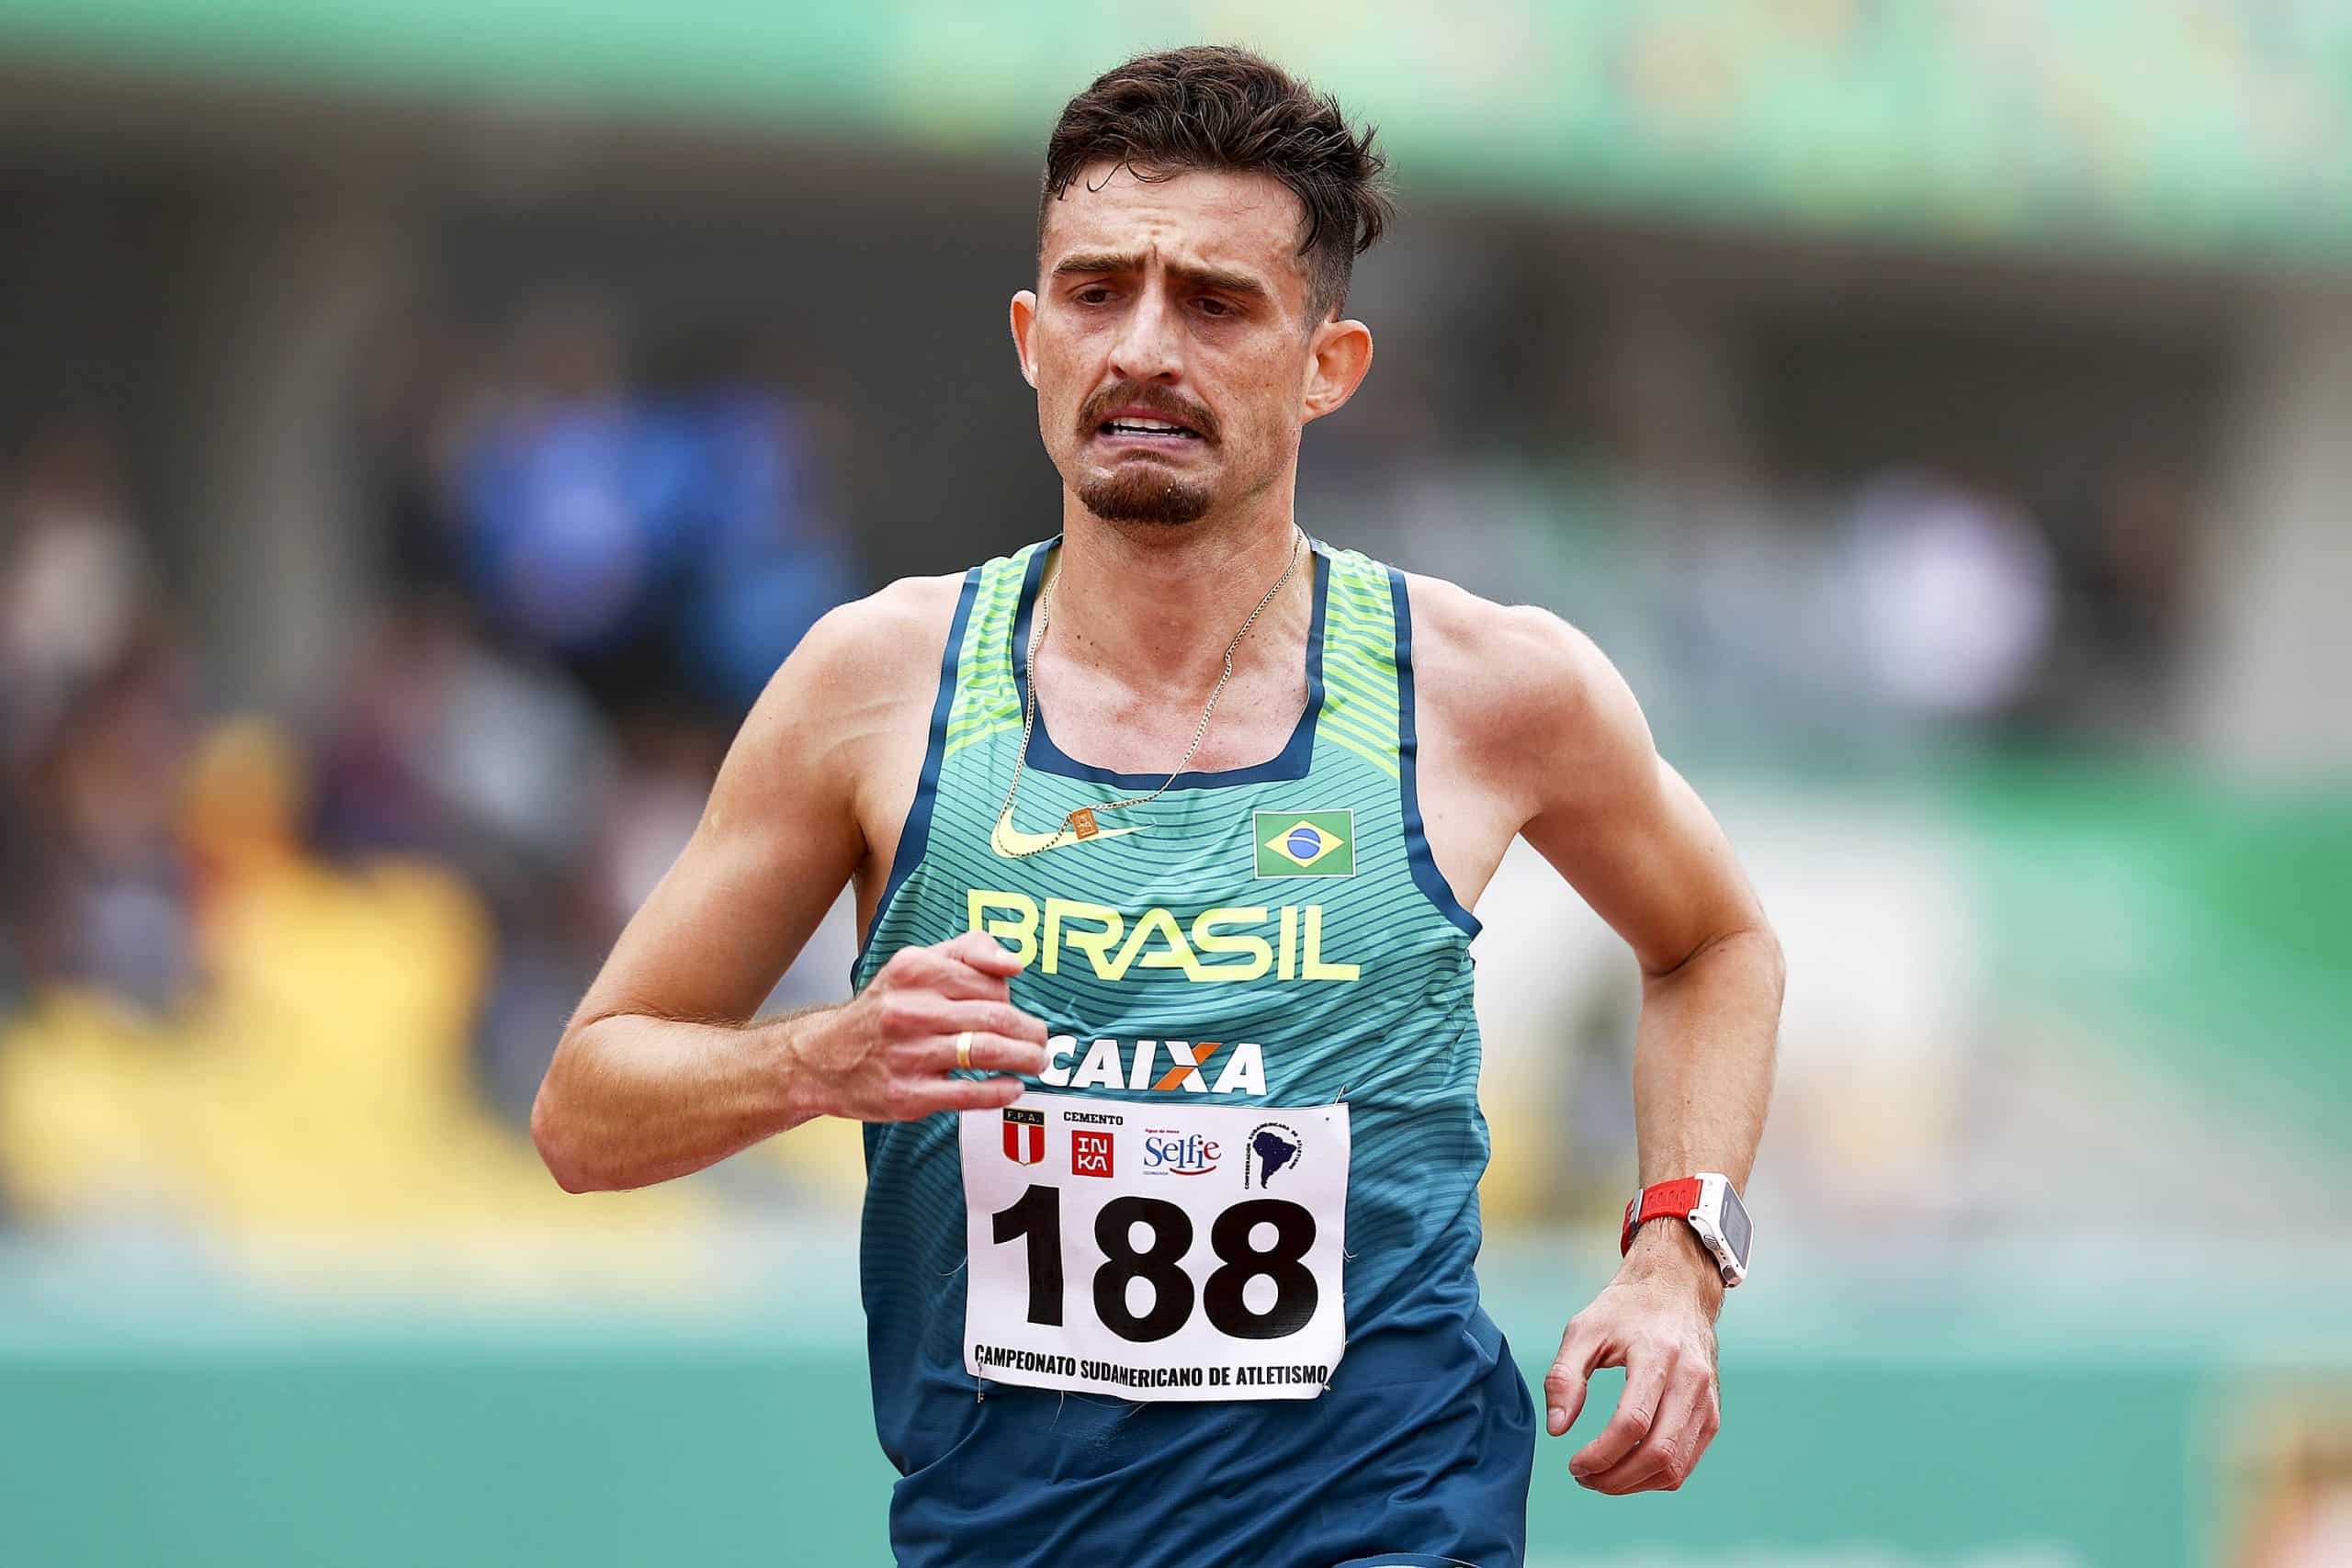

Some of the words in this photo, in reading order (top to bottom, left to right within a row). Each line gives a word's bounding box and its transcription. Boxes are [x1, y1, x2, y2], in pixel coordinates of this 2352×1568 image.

[967, 888, 1361, 982] BRASIL
[1038, 1035, 1268, 1096] CAIXA
[1063, 1111, 1124, 1125] CEMENTO
[1144, 1134, 1222, 1168] Selfie
[991, 1183, 1319, 1343] 188
[975, 1344, 1077, 1377] CAMPEONATO
[1080, 1359, 1204, 1389] SUDAMERICANO
[1209, 1367, 1231, 1387] DE
[1236, 1365, 1329, 1385] ATLETISMO
